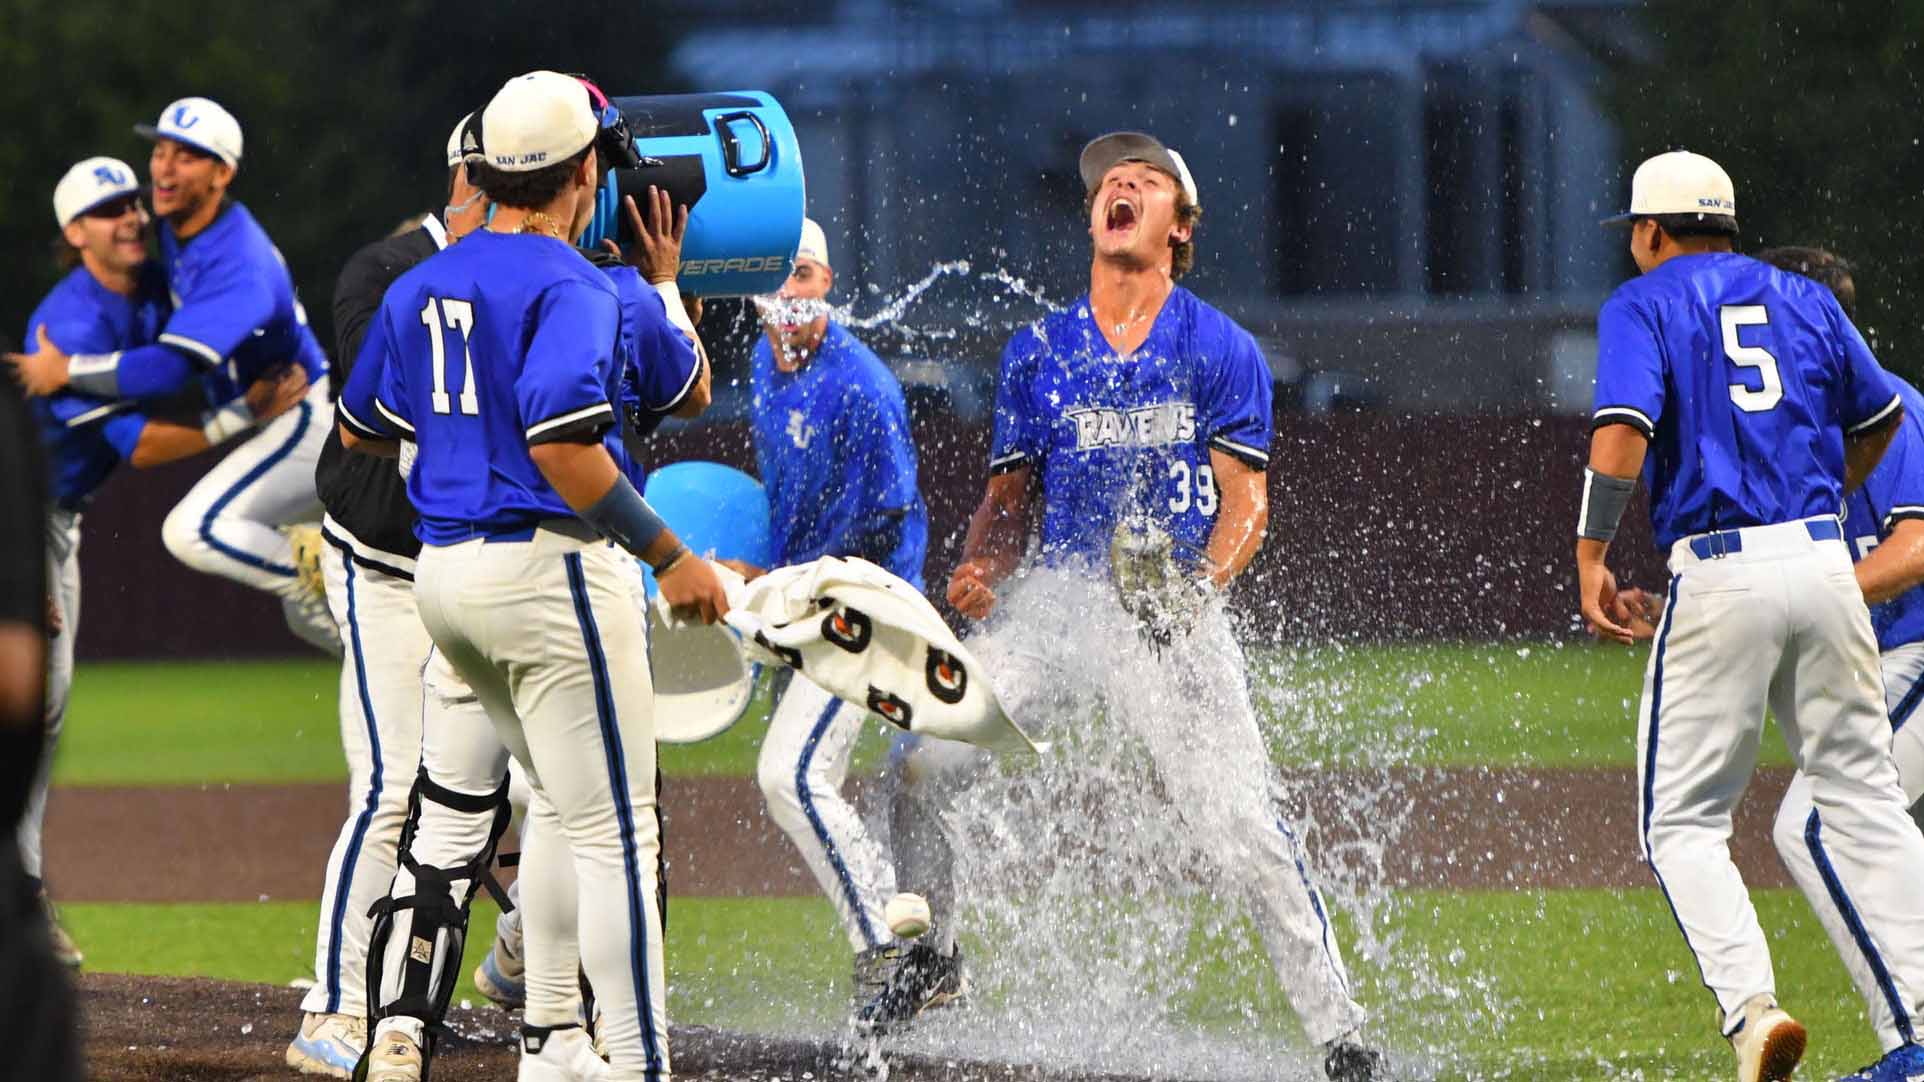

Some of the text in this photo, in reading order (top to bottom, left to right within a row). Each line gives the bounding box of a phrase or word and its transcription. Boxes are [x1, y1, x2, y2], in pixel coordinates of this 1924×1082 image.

[519, 151, 547, 165] JAC
[1698, 198, 1721, 208] SAN
[419, 295, 481, 416] 17
[1719, 303, 1785, 413] 5
[1063, 402, 1197, 451] RAVENS
[1168, 459, 1218, 517] 39
